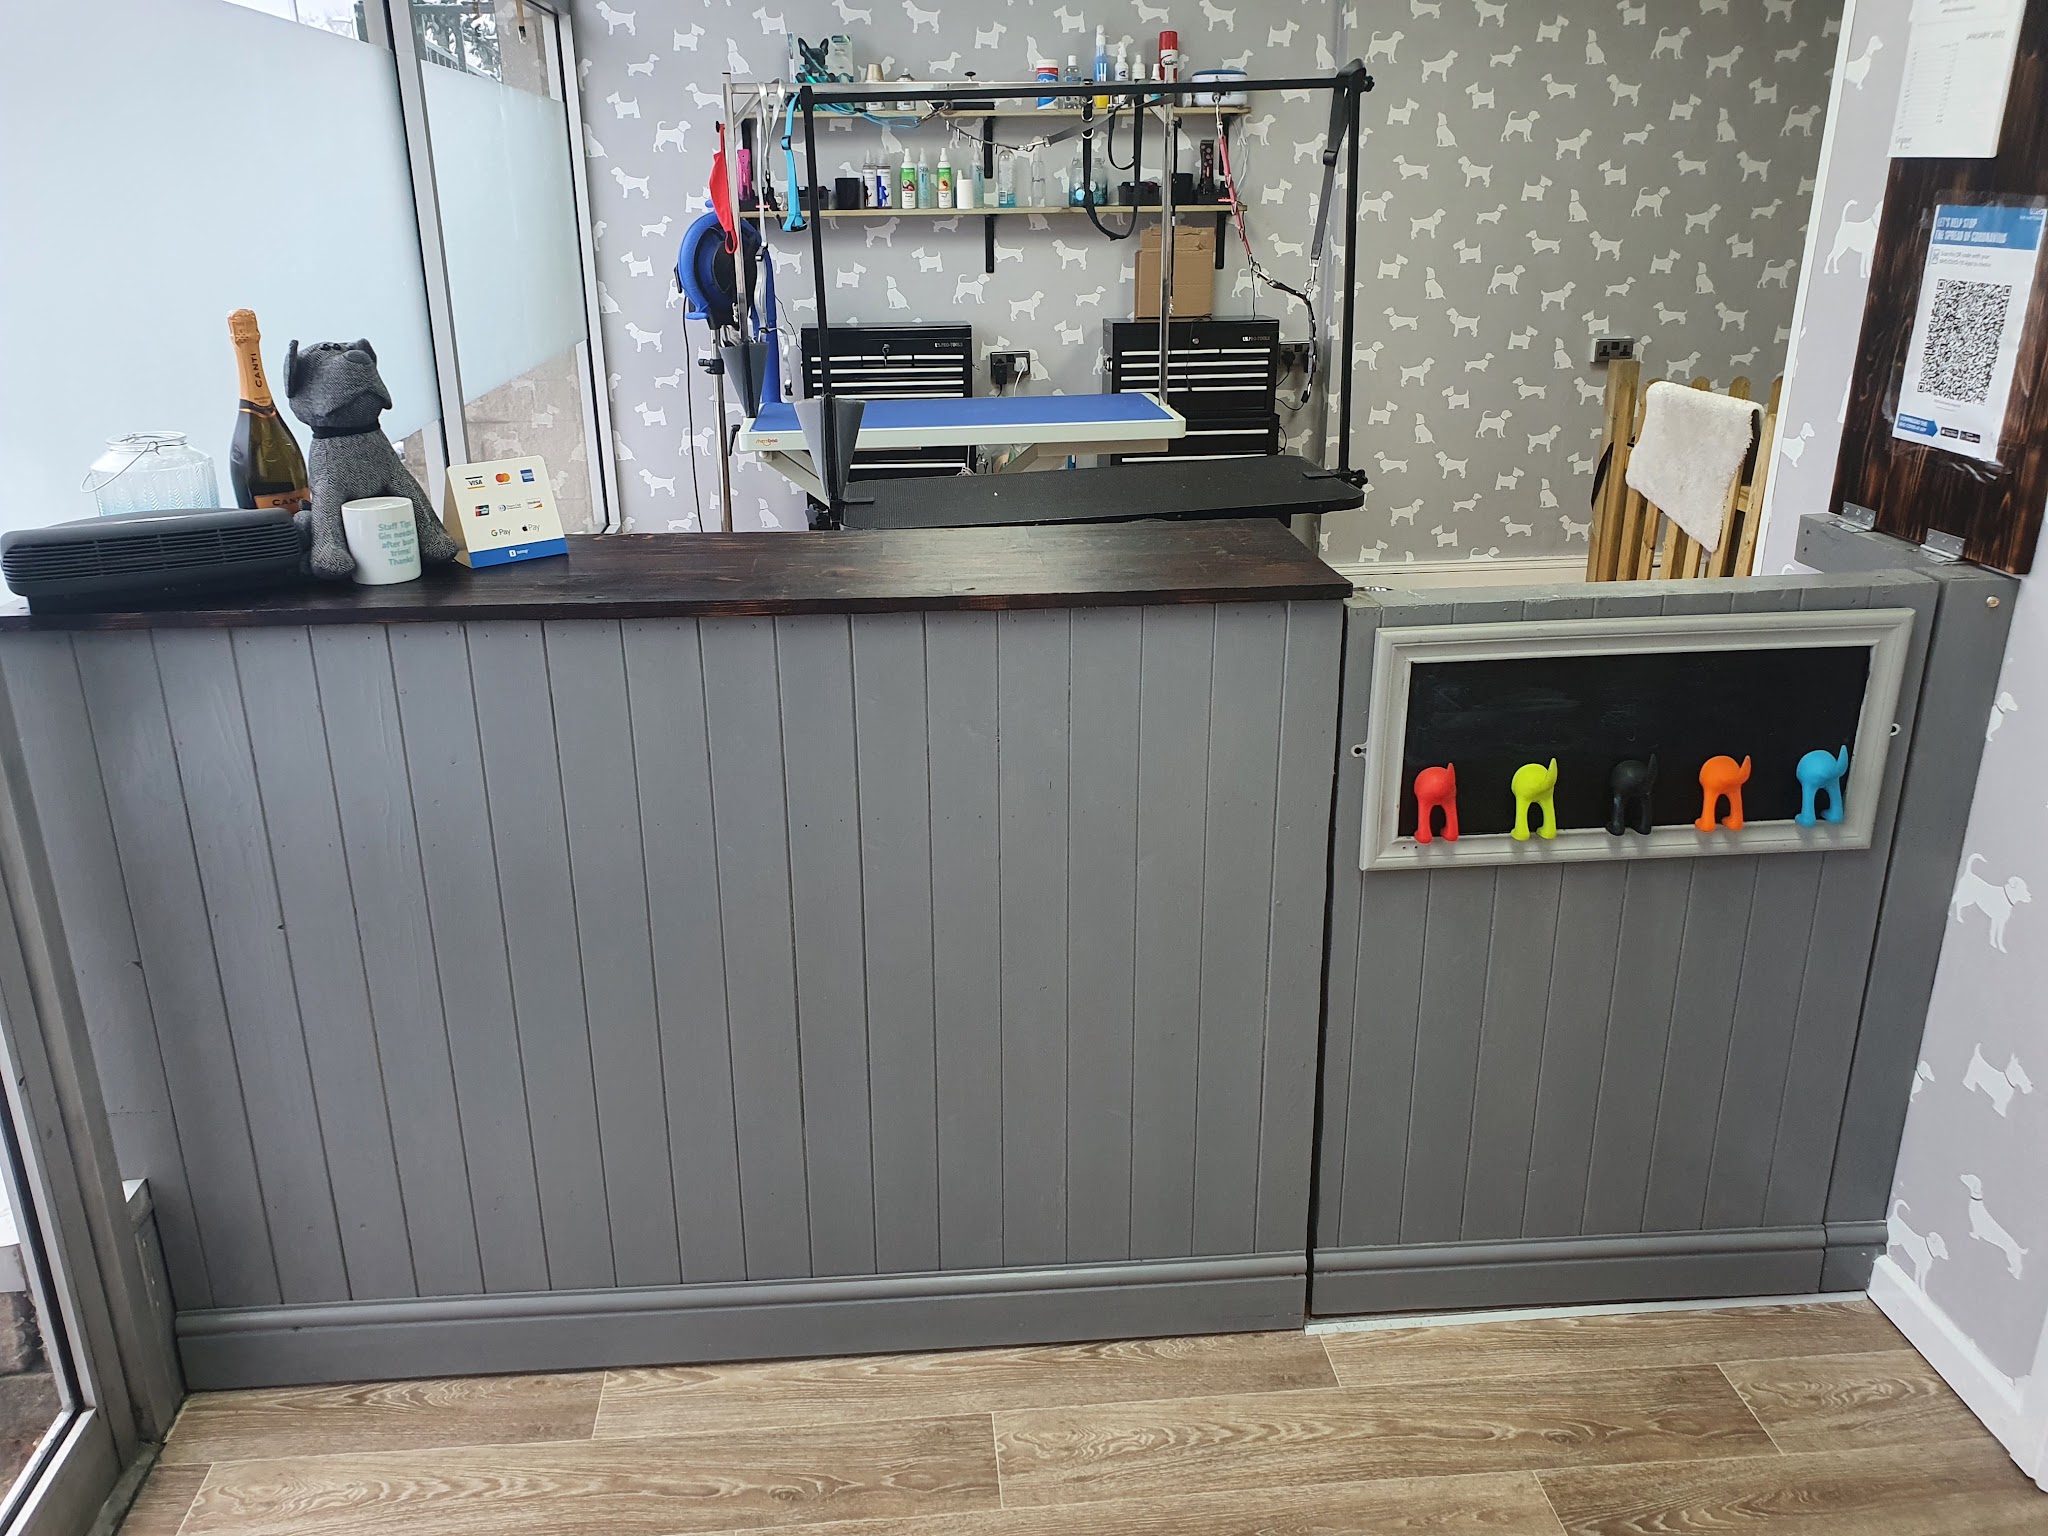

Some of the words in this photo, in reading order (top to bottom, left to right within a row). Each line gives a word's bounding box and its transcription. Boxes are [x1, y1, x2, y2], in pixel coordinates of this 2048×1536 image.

[1950, 217, 1963, 229] HELP
[1962, 217, 1978, 229] STOP
[1935, 230, 1945, 240] THE
[1944, 230, 1964, 241] SPREAD
[251, 353, 262, 388] CANTI
[272, 496, 303, 506] CANT
[378, 522, 398, 531] Staff
[528, 524, 540, 532] Pay
[378, 532, 392, 540] Gin
[499, 529, 511, 537] Pay
[382, 540, 400, 549] after
